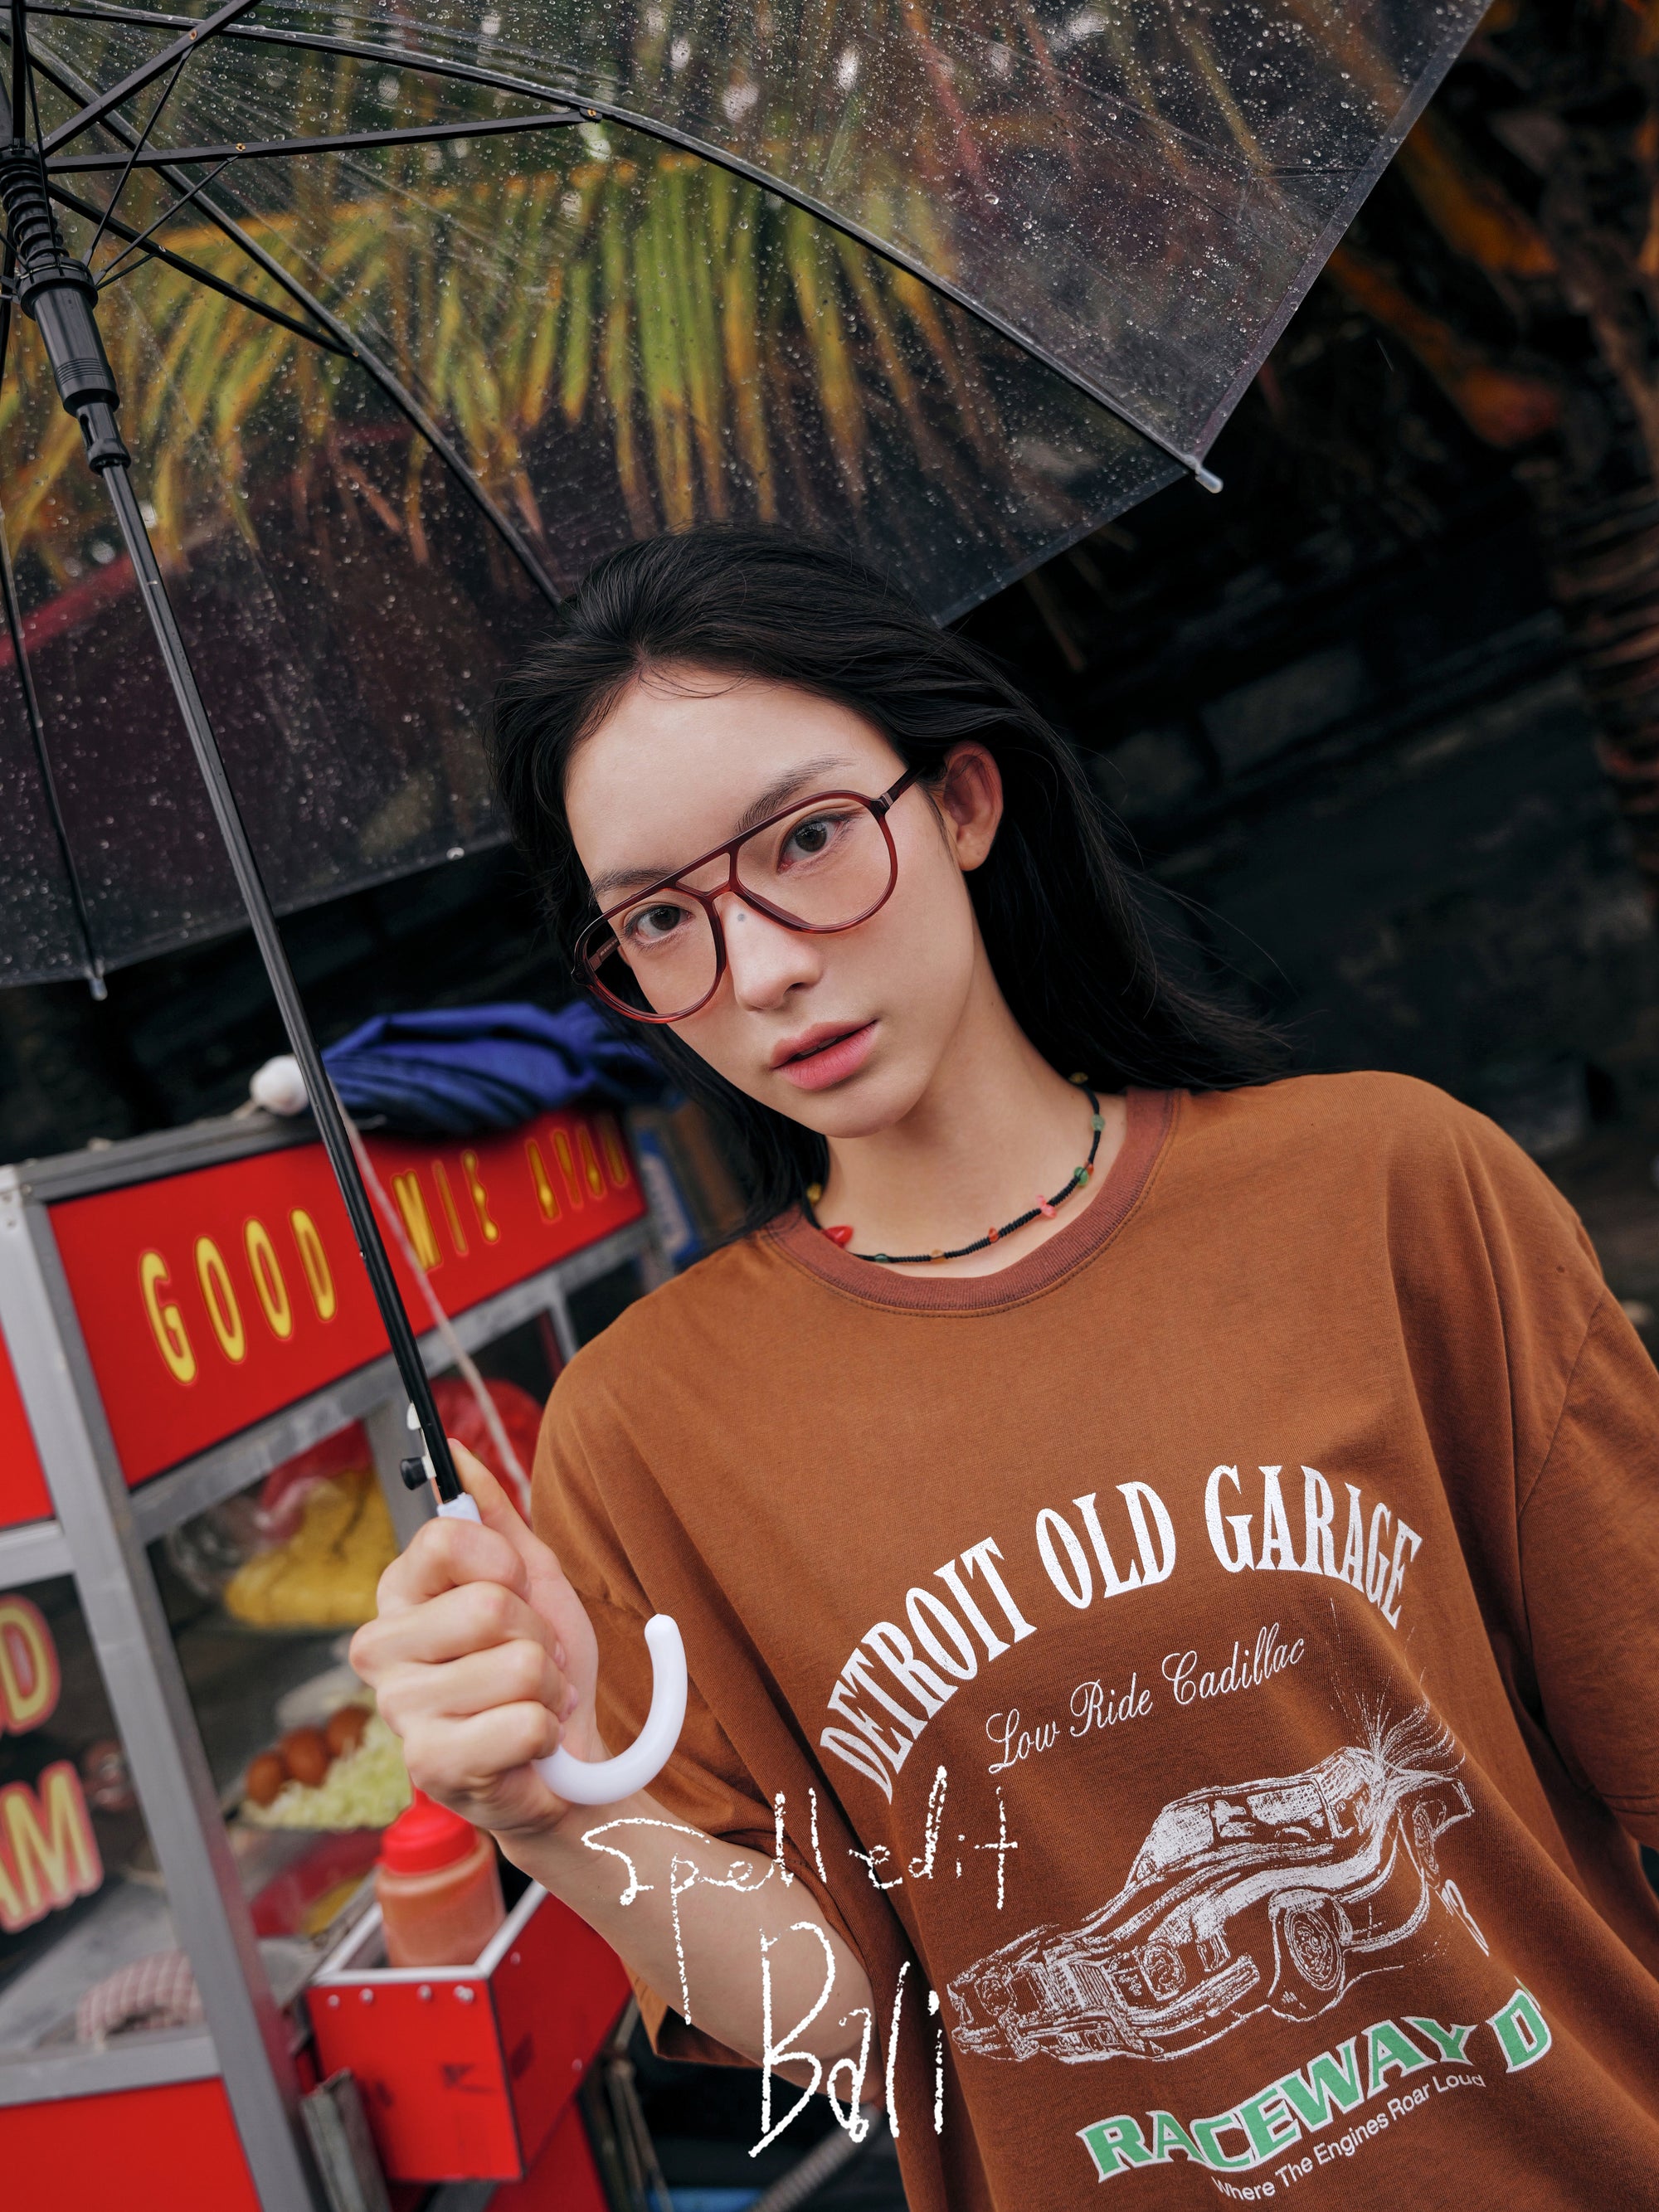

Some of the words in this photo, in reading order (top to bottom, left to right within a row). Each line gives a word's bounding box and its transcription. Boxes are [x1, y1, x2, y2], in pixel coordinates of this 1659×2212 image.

[139, 1206, 337, 1386] GOOD
[820, 1536, 1038, 1805] DETROIT
[1035, 1480, 1176, 1610] OLD
[1204, 1464, 1423, 1629] GARAGE
[985, 1708, 1061, 1775] Low
[1069, 1671, 1154, 1738] Ride
[1161, 1621, 1305, 1705] Cadillac
[1075, 2015, 1478, 2184] RACEWAY
[1485, 1976, 1553, 2073] D
[1211, 2176, 1276, 2201] Where
[1274, 2156, 1314, 2188] The
[1313, 2112, 1389, 2166] Engines
[1387, 2083, 1430, 2121] Roar
[1433, 2074, 1486, 2093] Loud
